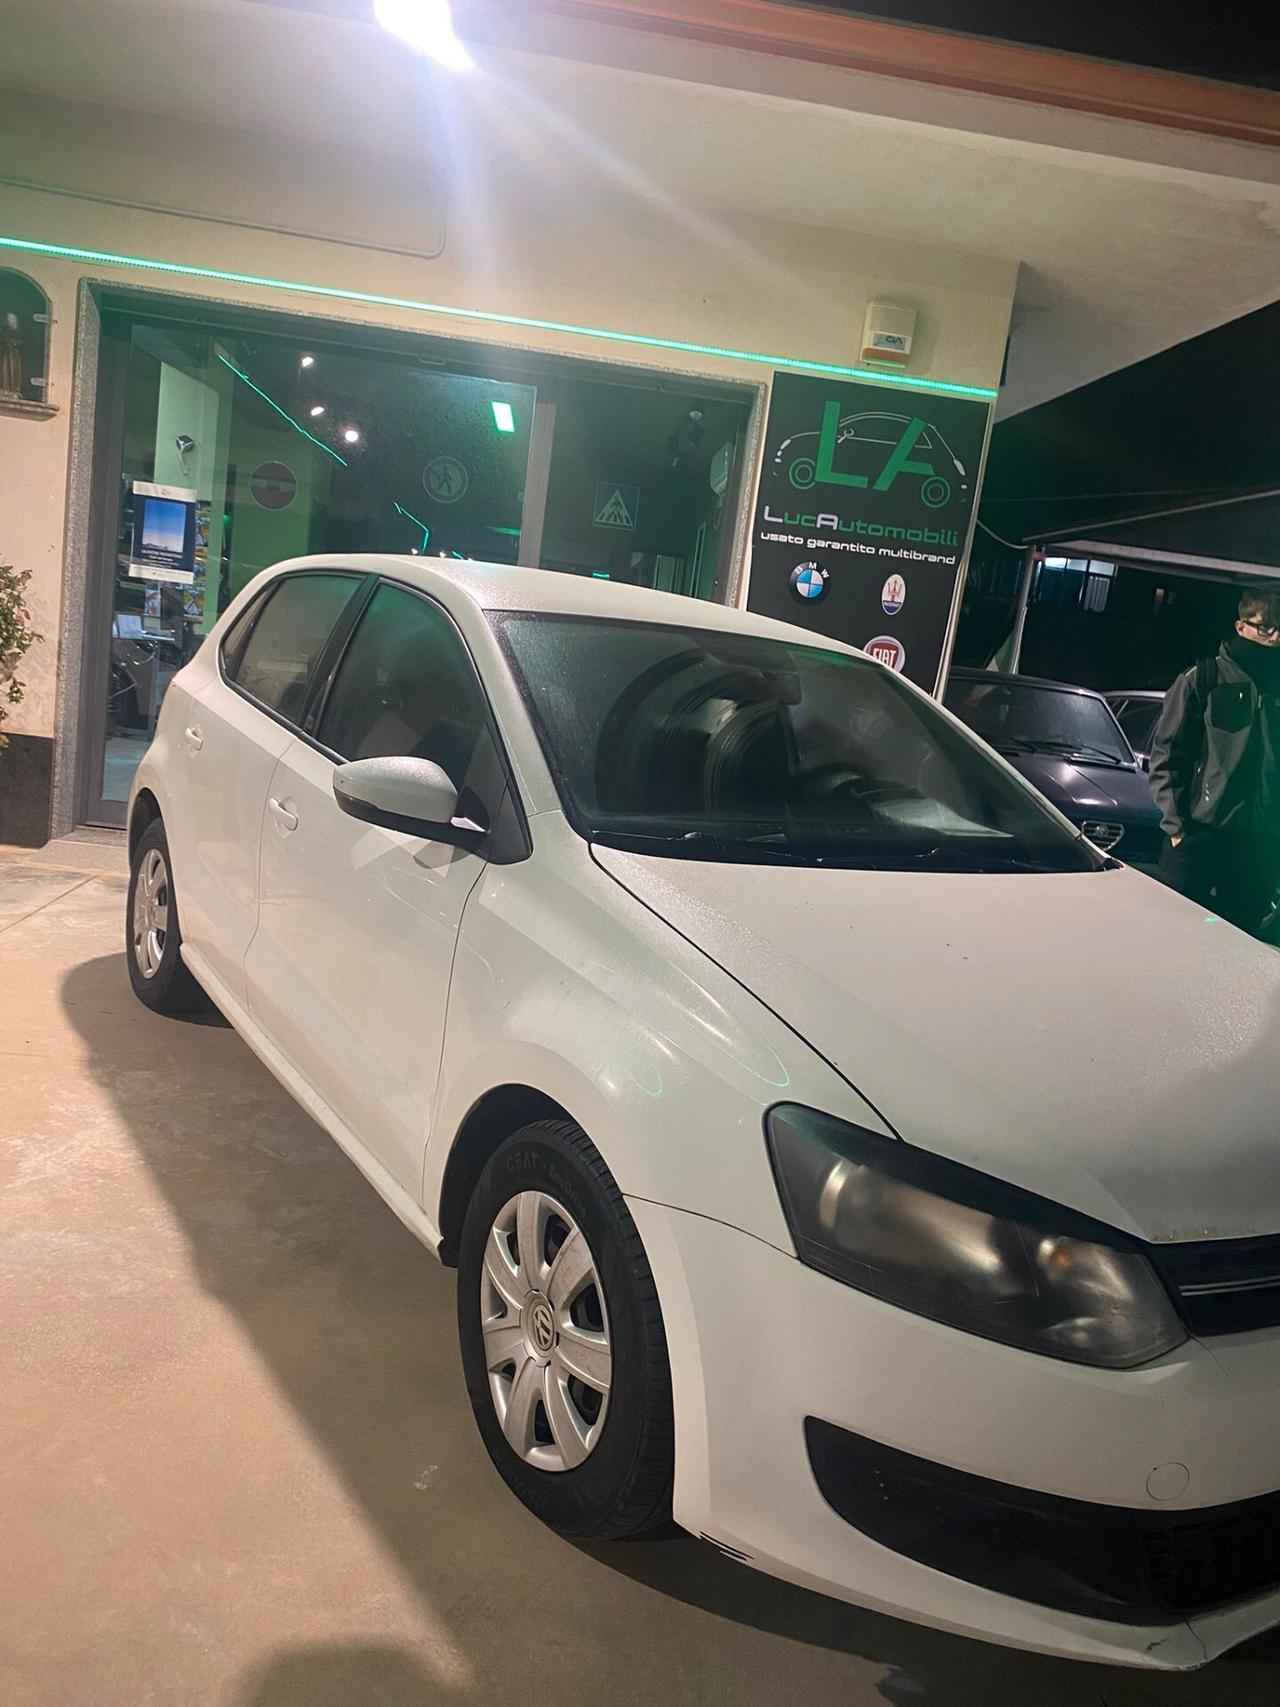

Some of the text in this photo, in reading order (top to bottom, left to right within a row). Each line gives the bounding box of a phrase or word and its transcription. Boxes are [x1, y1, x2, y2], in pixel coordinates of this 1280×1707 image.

[763, 505, 959, 547] LucAutomobili
[760, 531, 957, 566] usato garantito multibrand
[794, 560, 831, 580] BMW
[872, 647, 897, 668] FIAT
